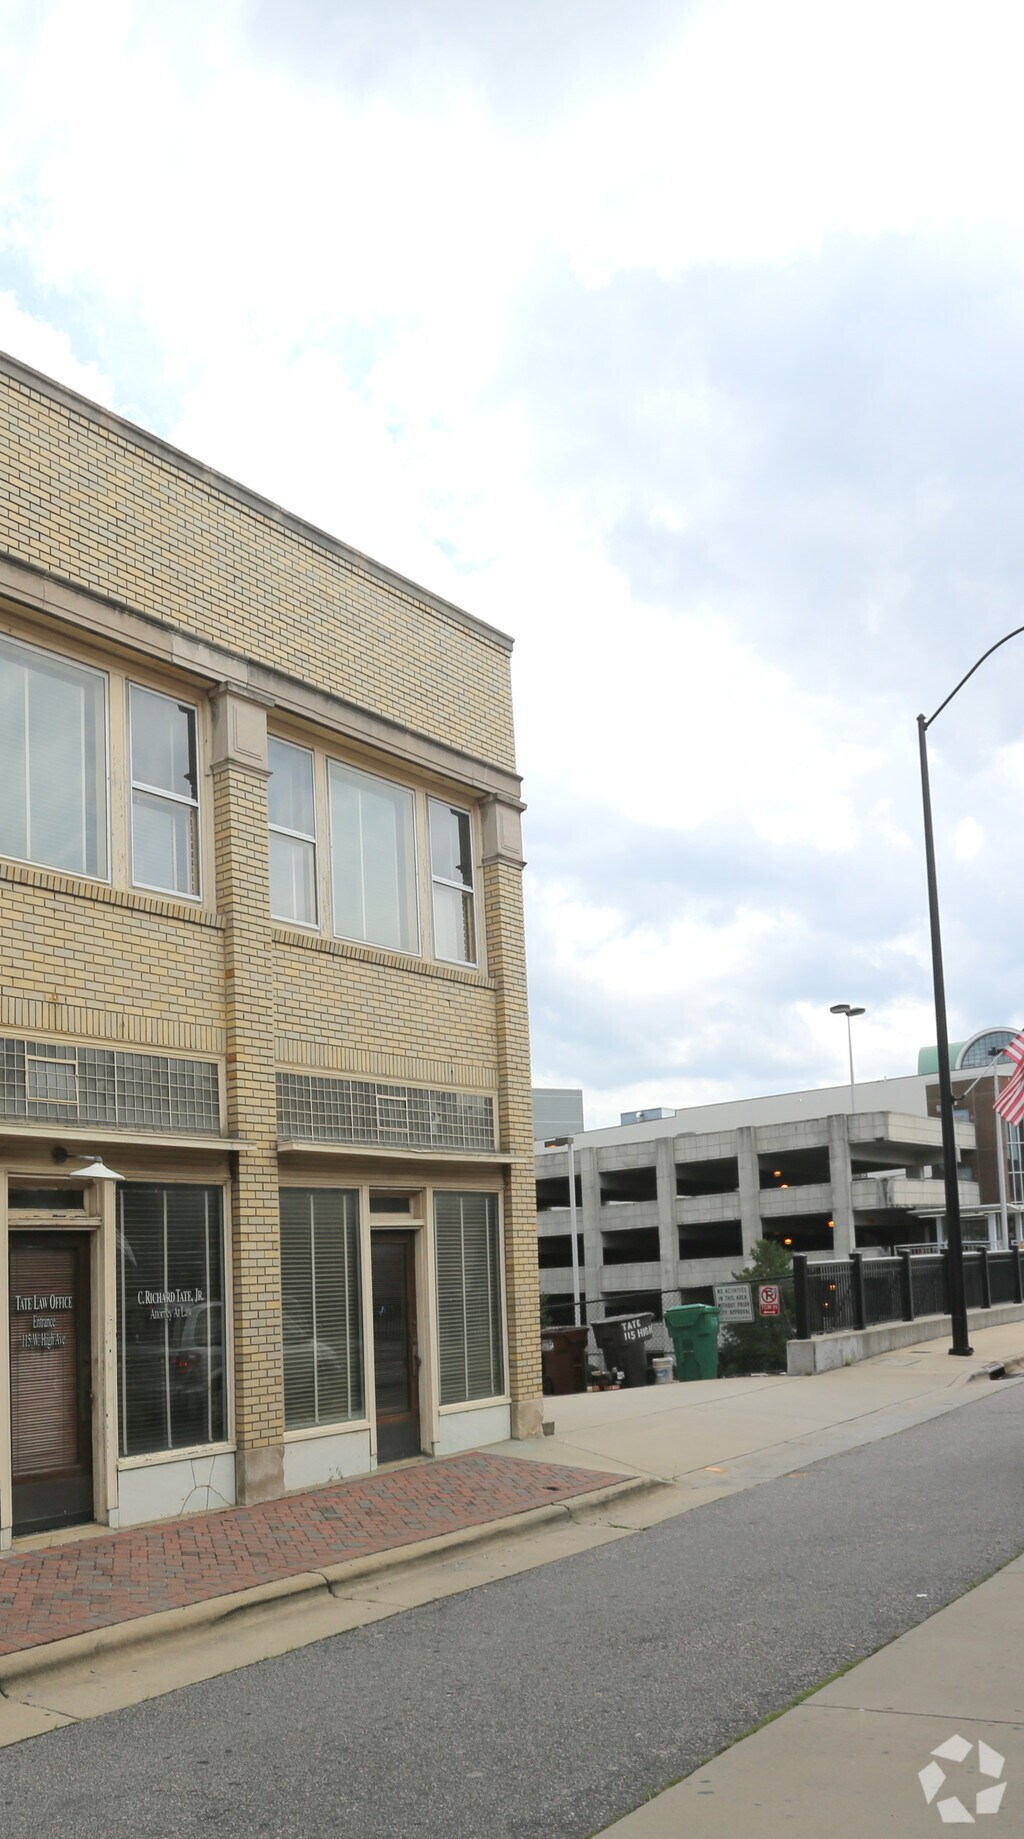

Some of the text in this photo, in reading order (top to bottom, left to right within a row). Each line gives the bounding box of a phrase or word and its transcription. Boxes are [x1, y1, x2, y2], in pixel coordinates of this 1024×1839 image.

[15, 1294, 72, 1310] TATE LAW OFFICE
[33, 1315, 56, 1328] Entrance
[621, 1319, 641, 1331] TATE
[624, 1331, 636, 1340] 115
